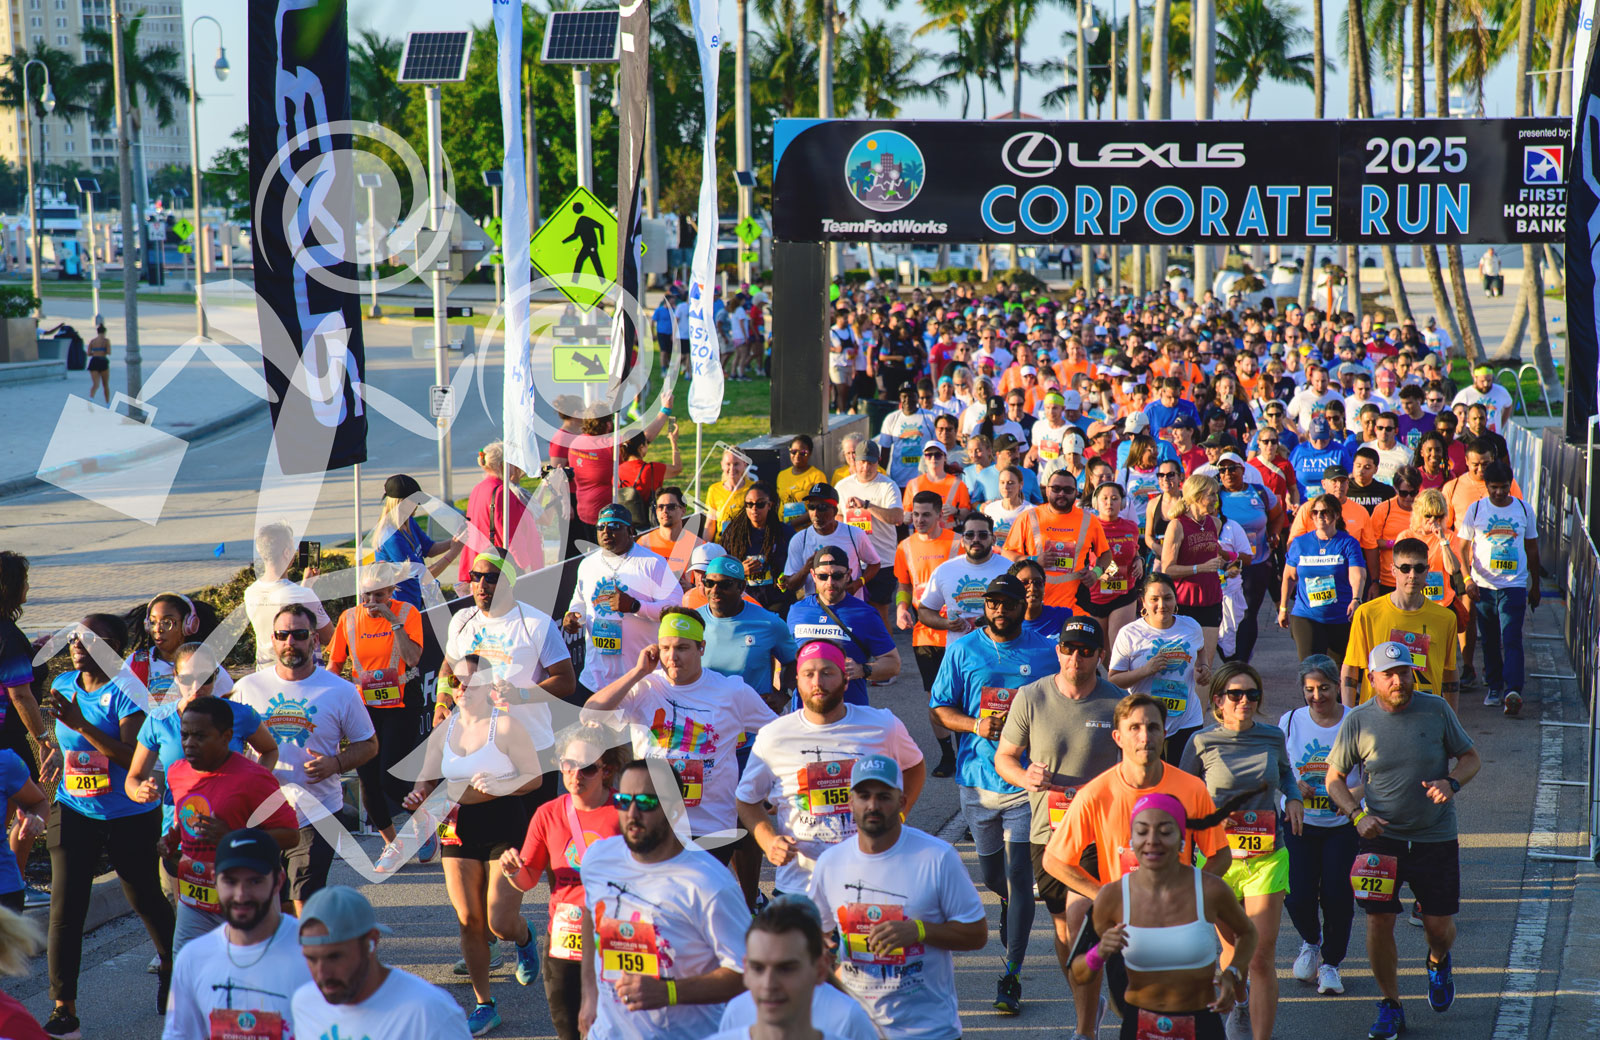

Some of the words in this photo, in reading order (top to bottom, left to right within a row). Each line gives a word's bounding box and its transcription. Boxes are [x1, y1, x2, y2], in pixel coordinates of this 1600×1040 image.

[1519, 129, 1554, 139] presented
[1558, 128, 1571, 138] by:
[1069, 142, 1246, 168] LEXUS
[1365, 137, 1468, 174] 2025
[1520, 189, 1566, 201] FIRST
[981, 184, 1333, 237] CORPORATE
[1361, 183, 1470, 235] RUN
[1504, 204, 1567, 218] HORIZO
[820, 218, 948, 235] TeamFootWorks
[1516, 219, 1566, 233] BANK
[1496, 561, 1513, 569] 1146
[1107, 582, 1122, 590] 249
[1312, 590, 1332, 600] 1033
[595, 637, 616, 649] 1026
[375, 689, 389, 700] 95
[860, 760, 886, 772] KAST
[76, 776, 98, 789] 281
[823, 788, 849, 805] 155
[1238, 836, 1261, 850] 213
[1361, 878, 1383, 892] 212
[188, 884, 209, 902] 241
[616, 954, 644, 972] 159
